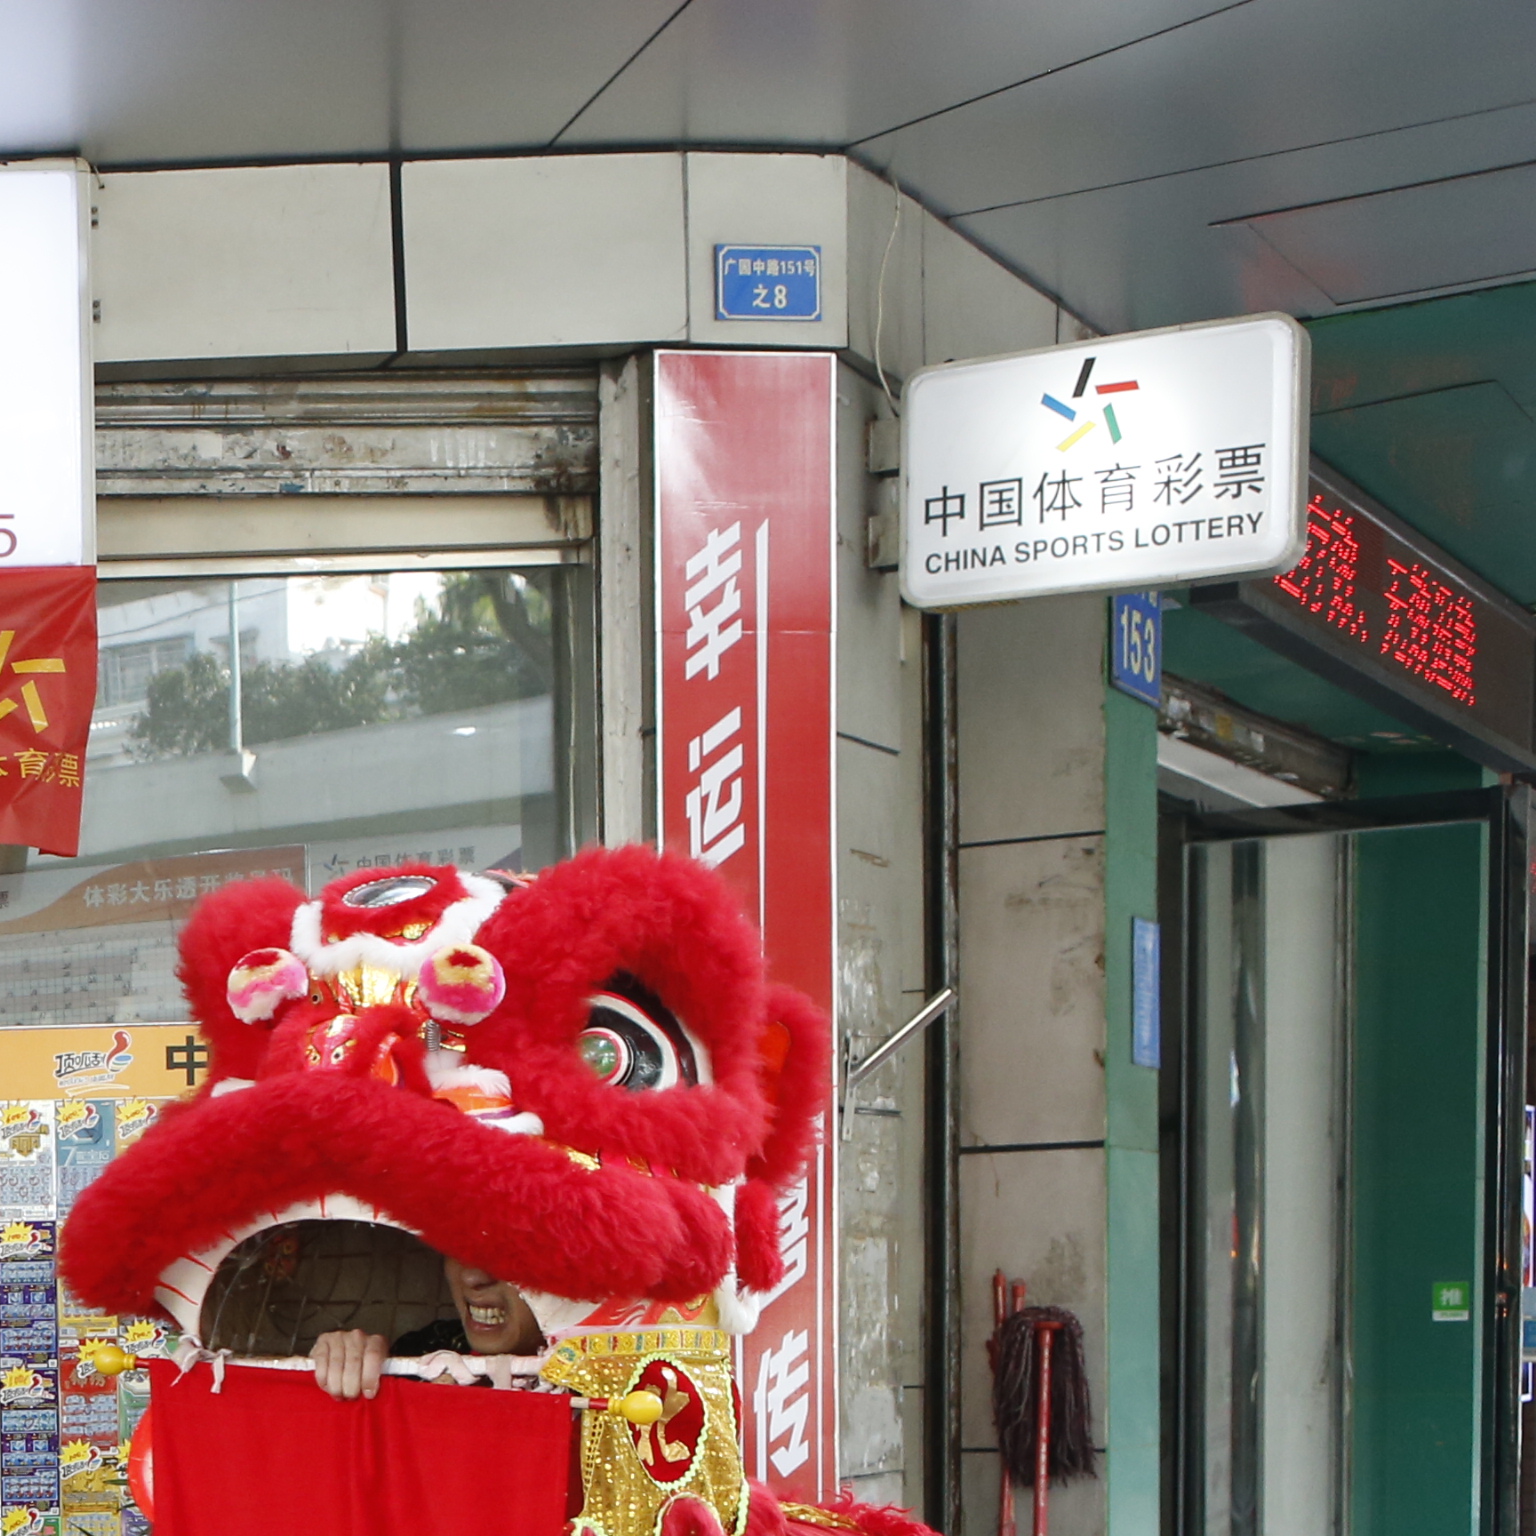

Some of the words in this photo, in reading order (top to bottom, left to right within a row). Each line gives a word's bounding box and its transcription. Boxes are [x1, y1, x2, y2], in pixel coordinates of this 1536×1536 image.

[752, 283, 787, 309] 之8
[922, 442, 1267, 539] 中国体育彩票
[924, 543, 1007, 575] CHINA
[1014, 529, 1125, 566] SPORTS
[1133, 511, 1265, 551] LOTTERY
[1121, 604, 1155, 683] 153
[166, 1035, 209, 1086] 中
